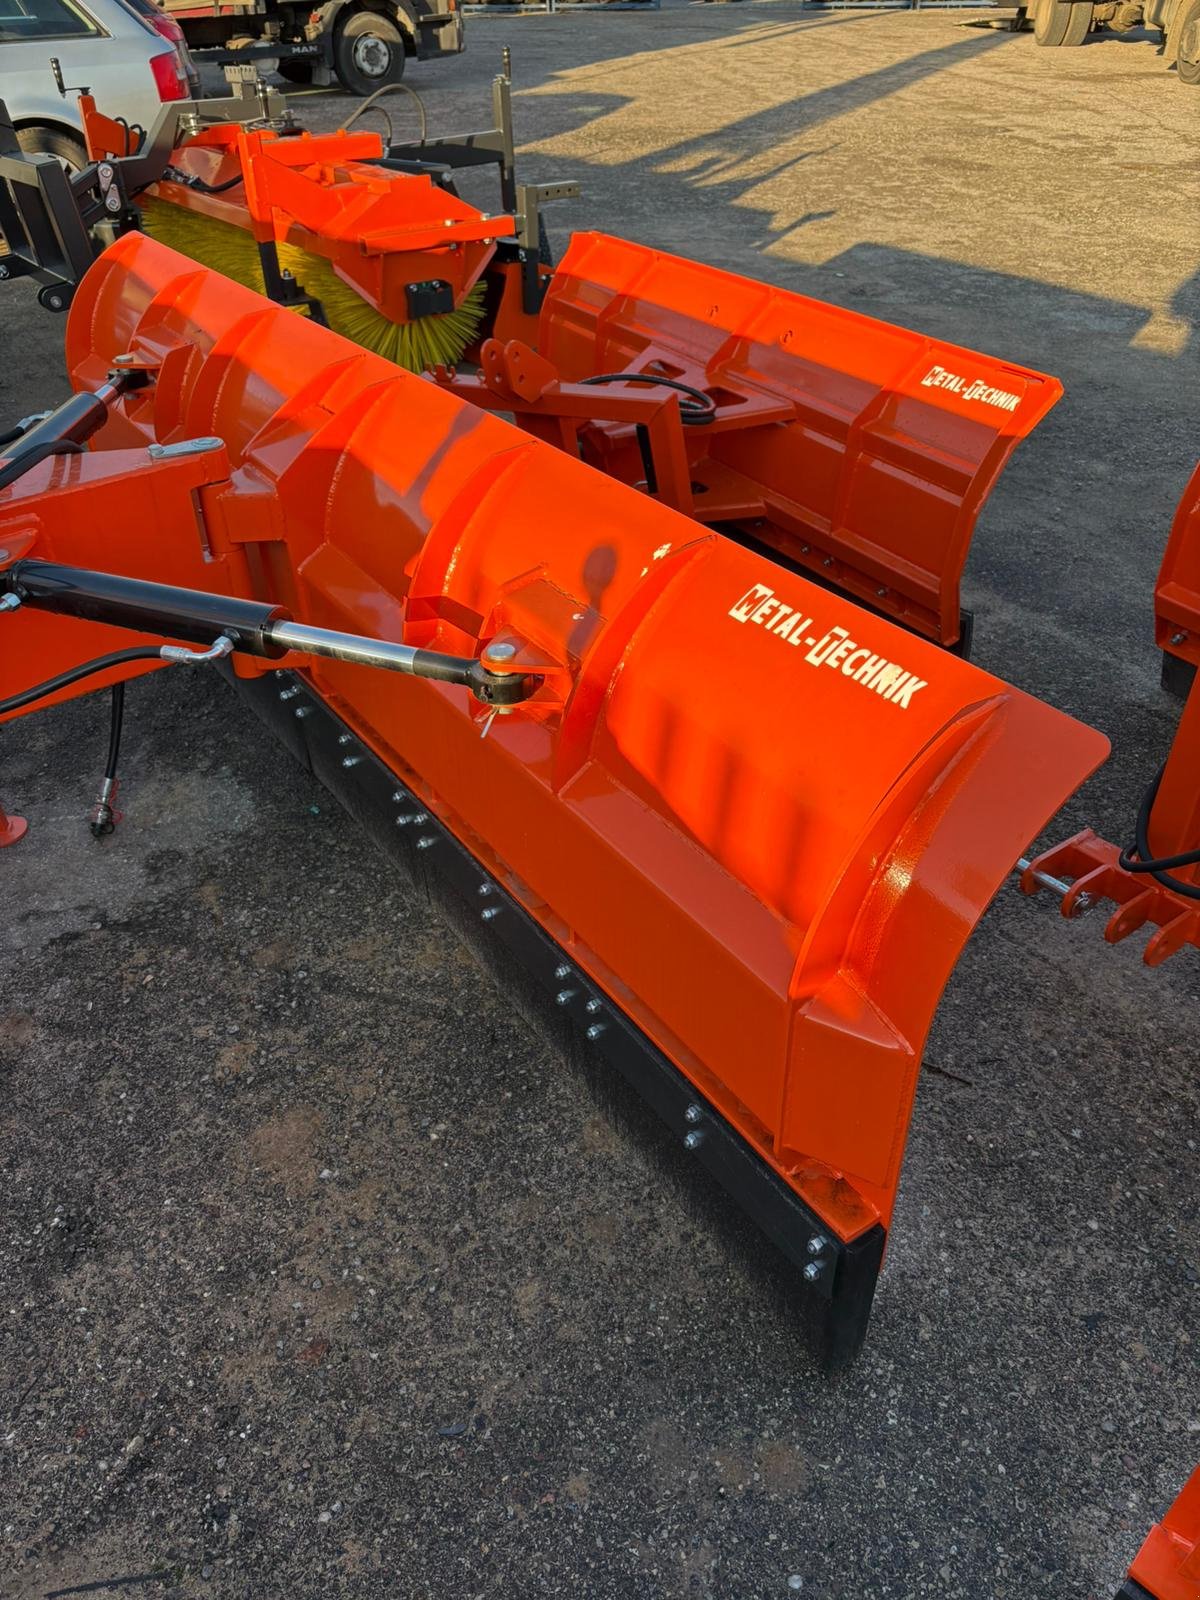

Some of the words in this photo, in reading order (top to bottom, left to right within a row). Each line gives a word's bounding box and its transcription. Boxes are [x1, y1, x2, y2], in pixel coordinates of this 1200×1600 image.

[291, 45, 318, 54] MAN
[921, 365, 1021, 412] METAL-TECHNIK
[728, 583, 928, 709] METAL-TECHNIK
